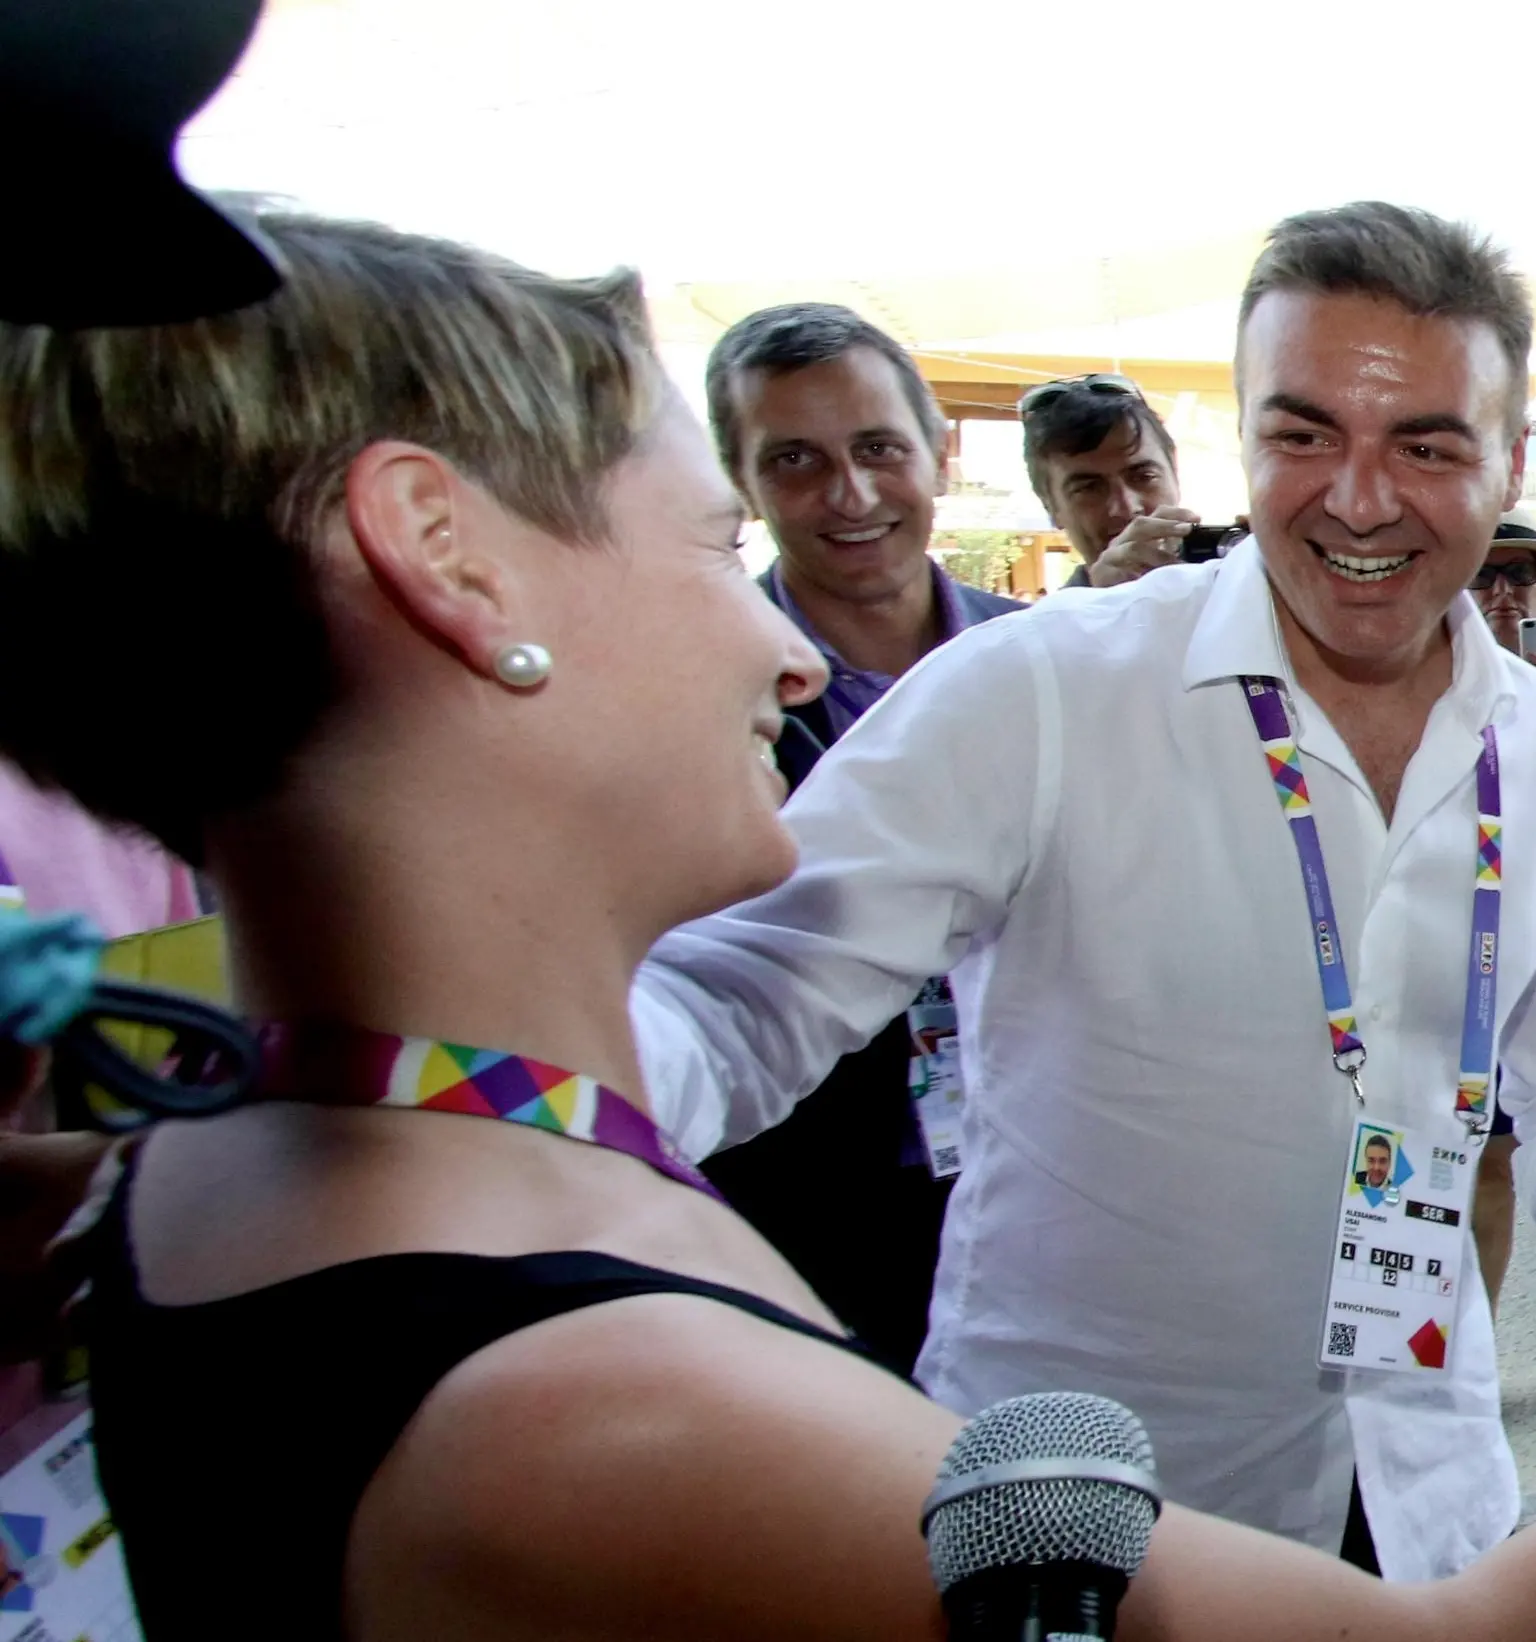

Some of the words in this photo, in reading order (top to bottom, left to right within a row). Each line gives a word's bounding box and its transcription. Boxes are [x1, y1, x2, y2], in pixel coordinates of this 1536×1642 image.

[1422, 1206, 1445, 1221] SER
[1373, 1251, 1381, 1262] 3
[1388, 1254, 1396, 1266] 4
[1402, 1256, 1410, 1268] 5
[1431, 1262, 1439, 1273] 7
[1384, 1272, 1397, 1284] 12
[1333, 1301, 1365, 1313] SERVICE
[1365, 1306, 1401, 1318] PROVIDER
